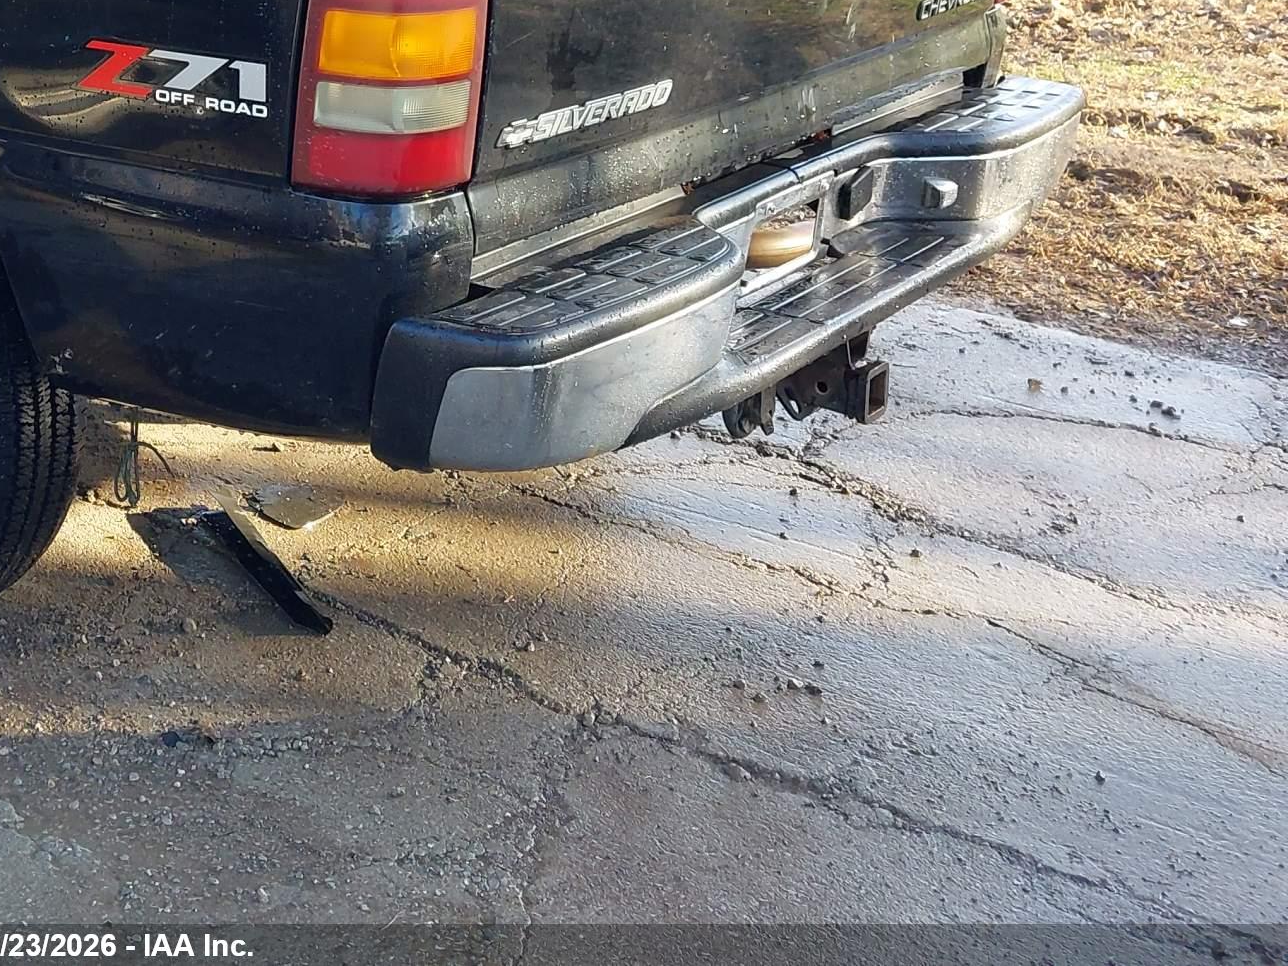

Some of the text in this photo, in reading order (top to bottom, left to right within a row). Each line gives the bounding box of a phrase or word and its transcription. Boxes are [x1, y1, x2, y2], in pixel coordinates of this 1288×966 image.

[77, 39, 267, 103] Z71
[155, 89, 269, 119] OFF ROAD
[530, 78, 674, 143] SILVERADO
